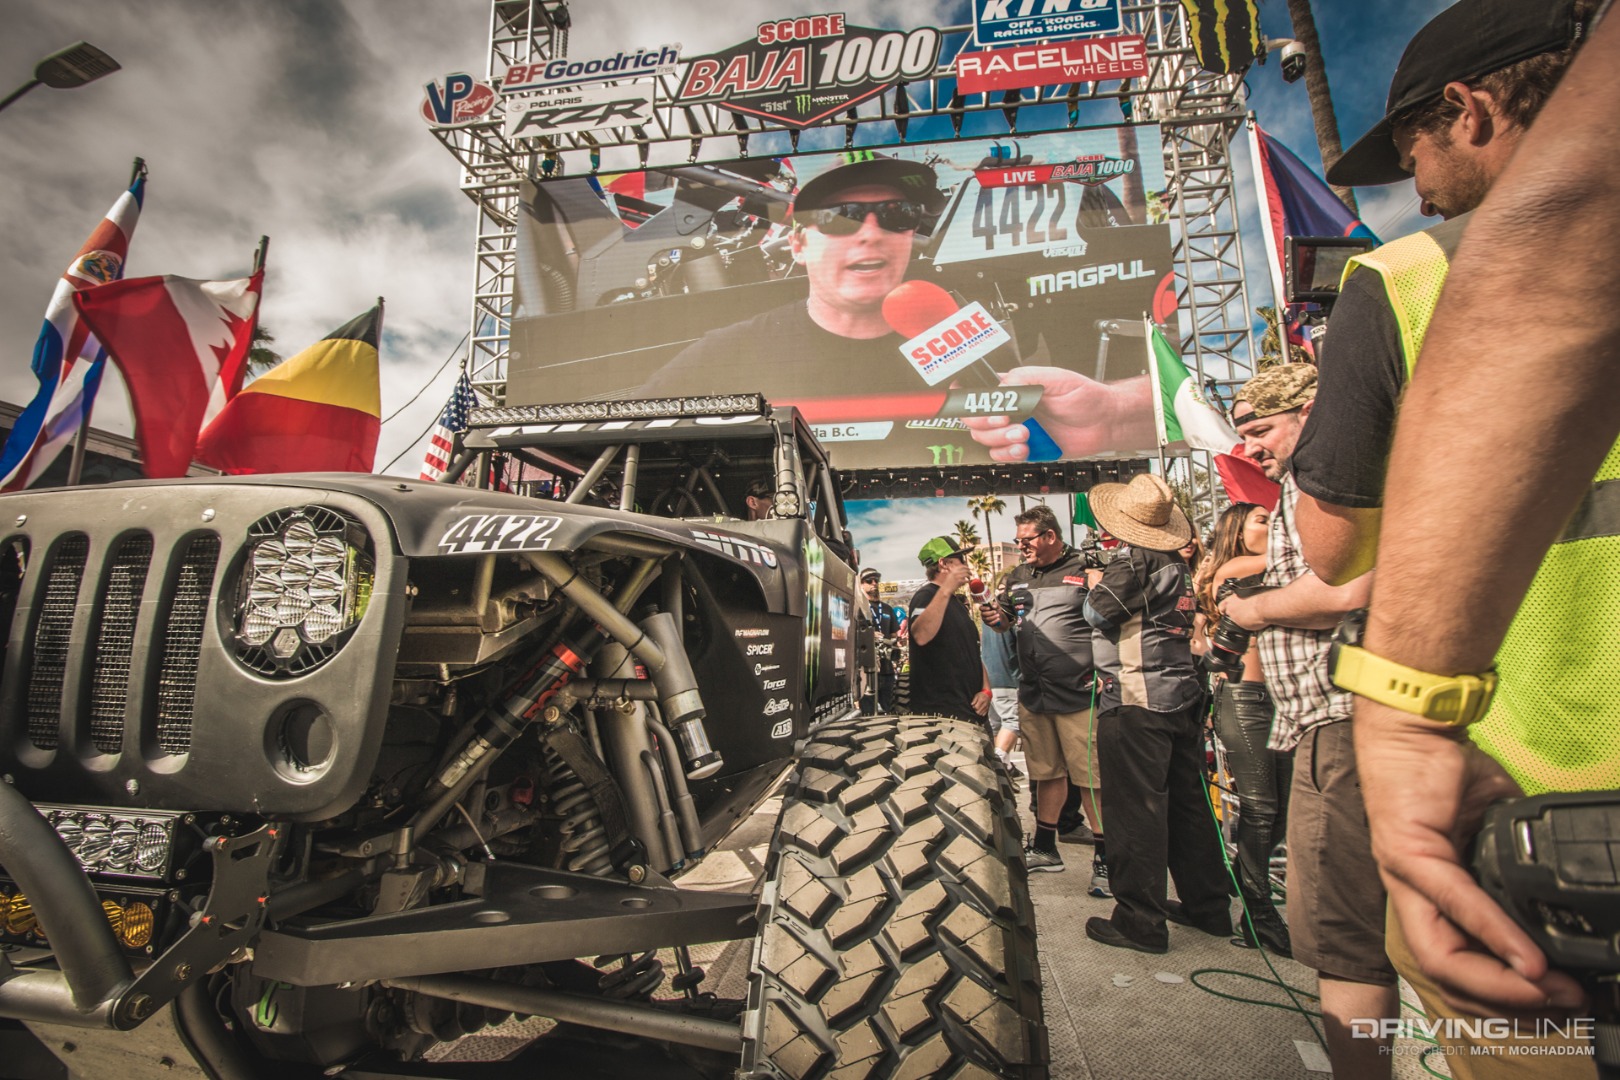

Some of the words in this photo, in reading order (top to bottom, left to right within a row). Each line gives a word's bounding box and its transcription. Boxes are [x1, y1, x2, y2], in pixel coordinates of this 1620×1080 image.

[758, 14, 844, 45] SCORE
[993, 27, 1043, 38] RACING
[1046, 21, 1097, 32] SHOCKS
[504, 46, 678, 85] BFGoodrich
[656, 66, 674, 74] Tires
[680, 47, 806, 98] BAJA
[819, 28, 939, 84] 1000
[957, 40, 1143, 78] RACELINE
[1063, 60, 1145, 77] WHEELS
[426, 74, 473, 124] VP
[456, 95, 495, 117] Racing
[530, 96, 582, 109] POLARIS
[812, 94, 849, 103] MONSTER
[512, 98, 649, 135] RZR
[1053, 163, 1093, 177] BAJA
[1097, 159, 1134, 174] 1000
[1076, 154, 1105, 162] SCORE
[1003, 170, 1036, 184] LIVE
[972, 183, 1068, 250] 4422
[1030, 260, 1155, 296] MAGPUL
[911, 311, 992, 366] SCORE
[924, 327, 993, 371] INTERNATIONAL
[964, 391, 1018, 413] 4422
[832, 426, 859, 437] B.C.
[440, 515, 562, 553] 4422
[746, 644, 773, 655] SPICER
[763, 679, 787, 690] Torco
